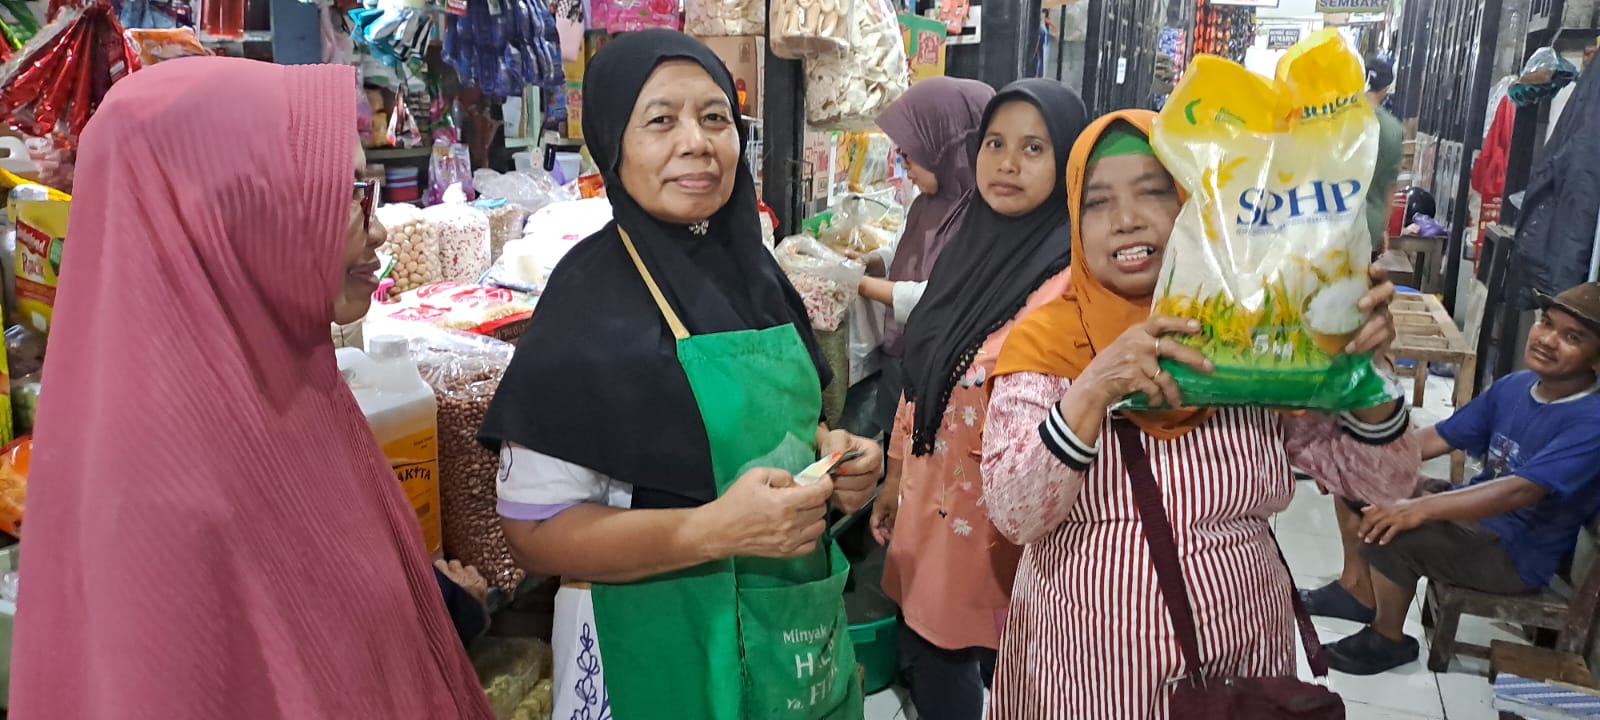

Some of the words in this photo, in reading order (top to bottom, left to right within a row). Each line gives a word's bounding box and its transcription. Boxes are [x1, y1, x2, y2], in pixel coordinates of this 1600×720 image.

[1236, 178, 1361, 226] SPHP
[1253, 333, 1269, 355] 5
[783, 624, 828, 645] Minyak
